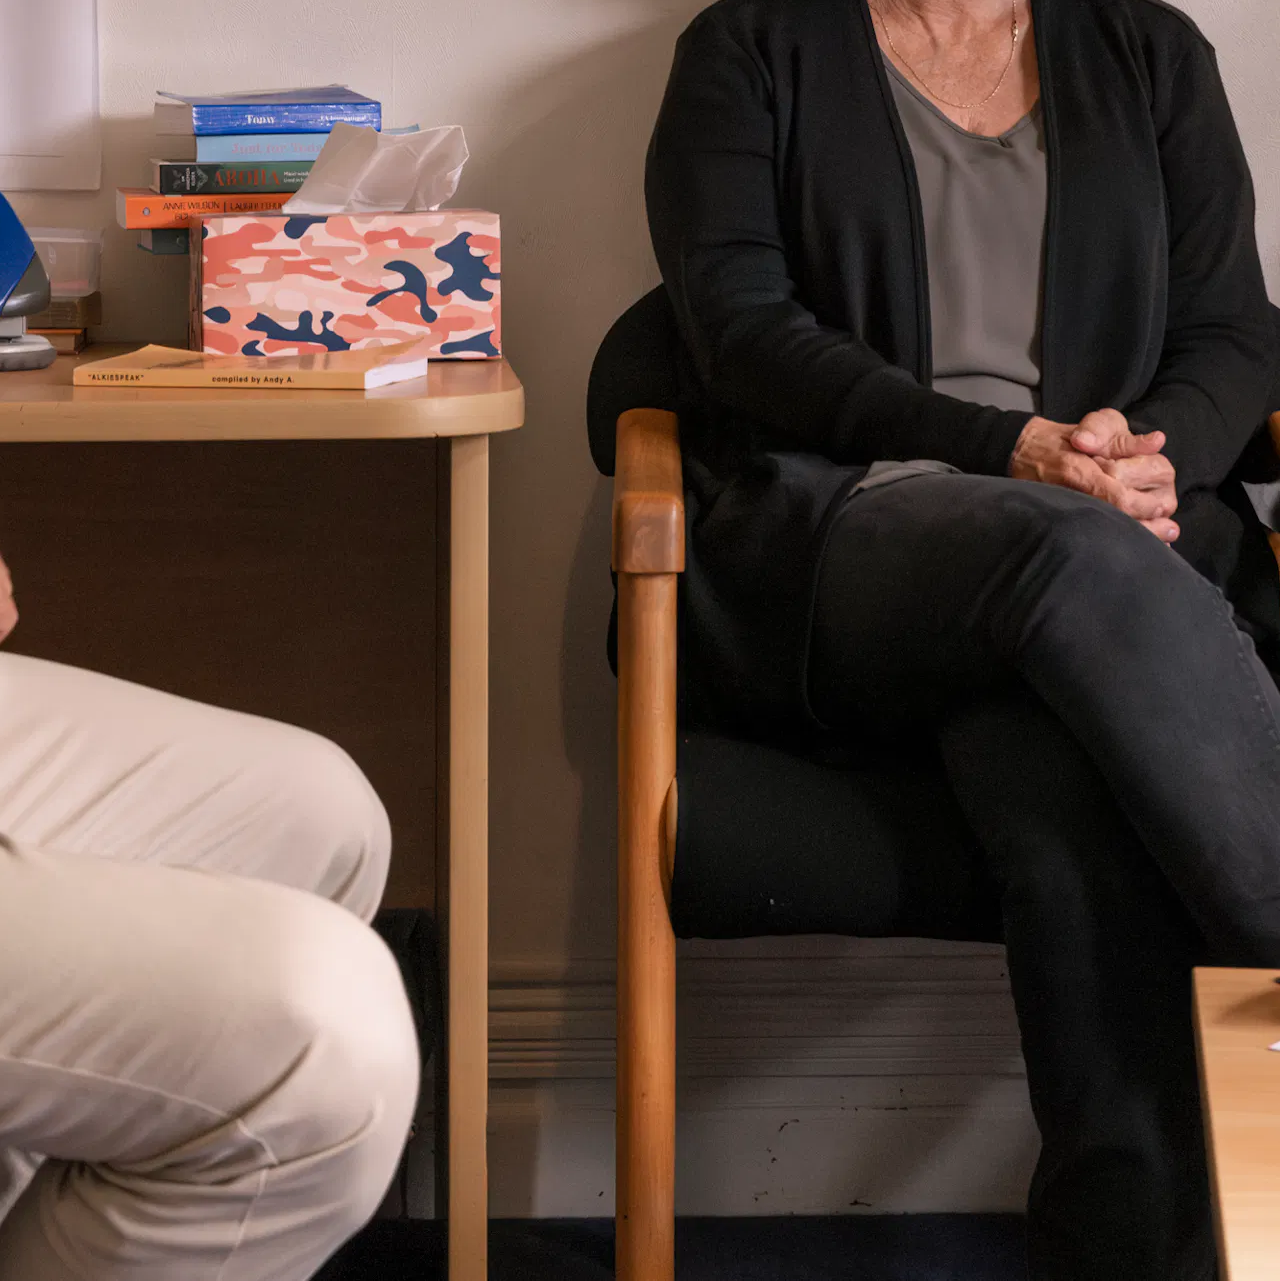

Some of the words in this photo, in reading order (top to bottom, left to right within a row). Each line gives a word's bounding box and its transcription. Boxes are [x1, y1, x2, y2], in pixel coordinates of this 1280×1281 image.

[231, 142, 262, 155] Just
[265, 142, 287, 154] for
[291, 142, 323, 153] Toda
[214, 168, 281, 188] AROHA
[162, 202, 186, 211] ANNE
[251, 376, 261, 385] by
[263, 377, 284, 385] Andy
